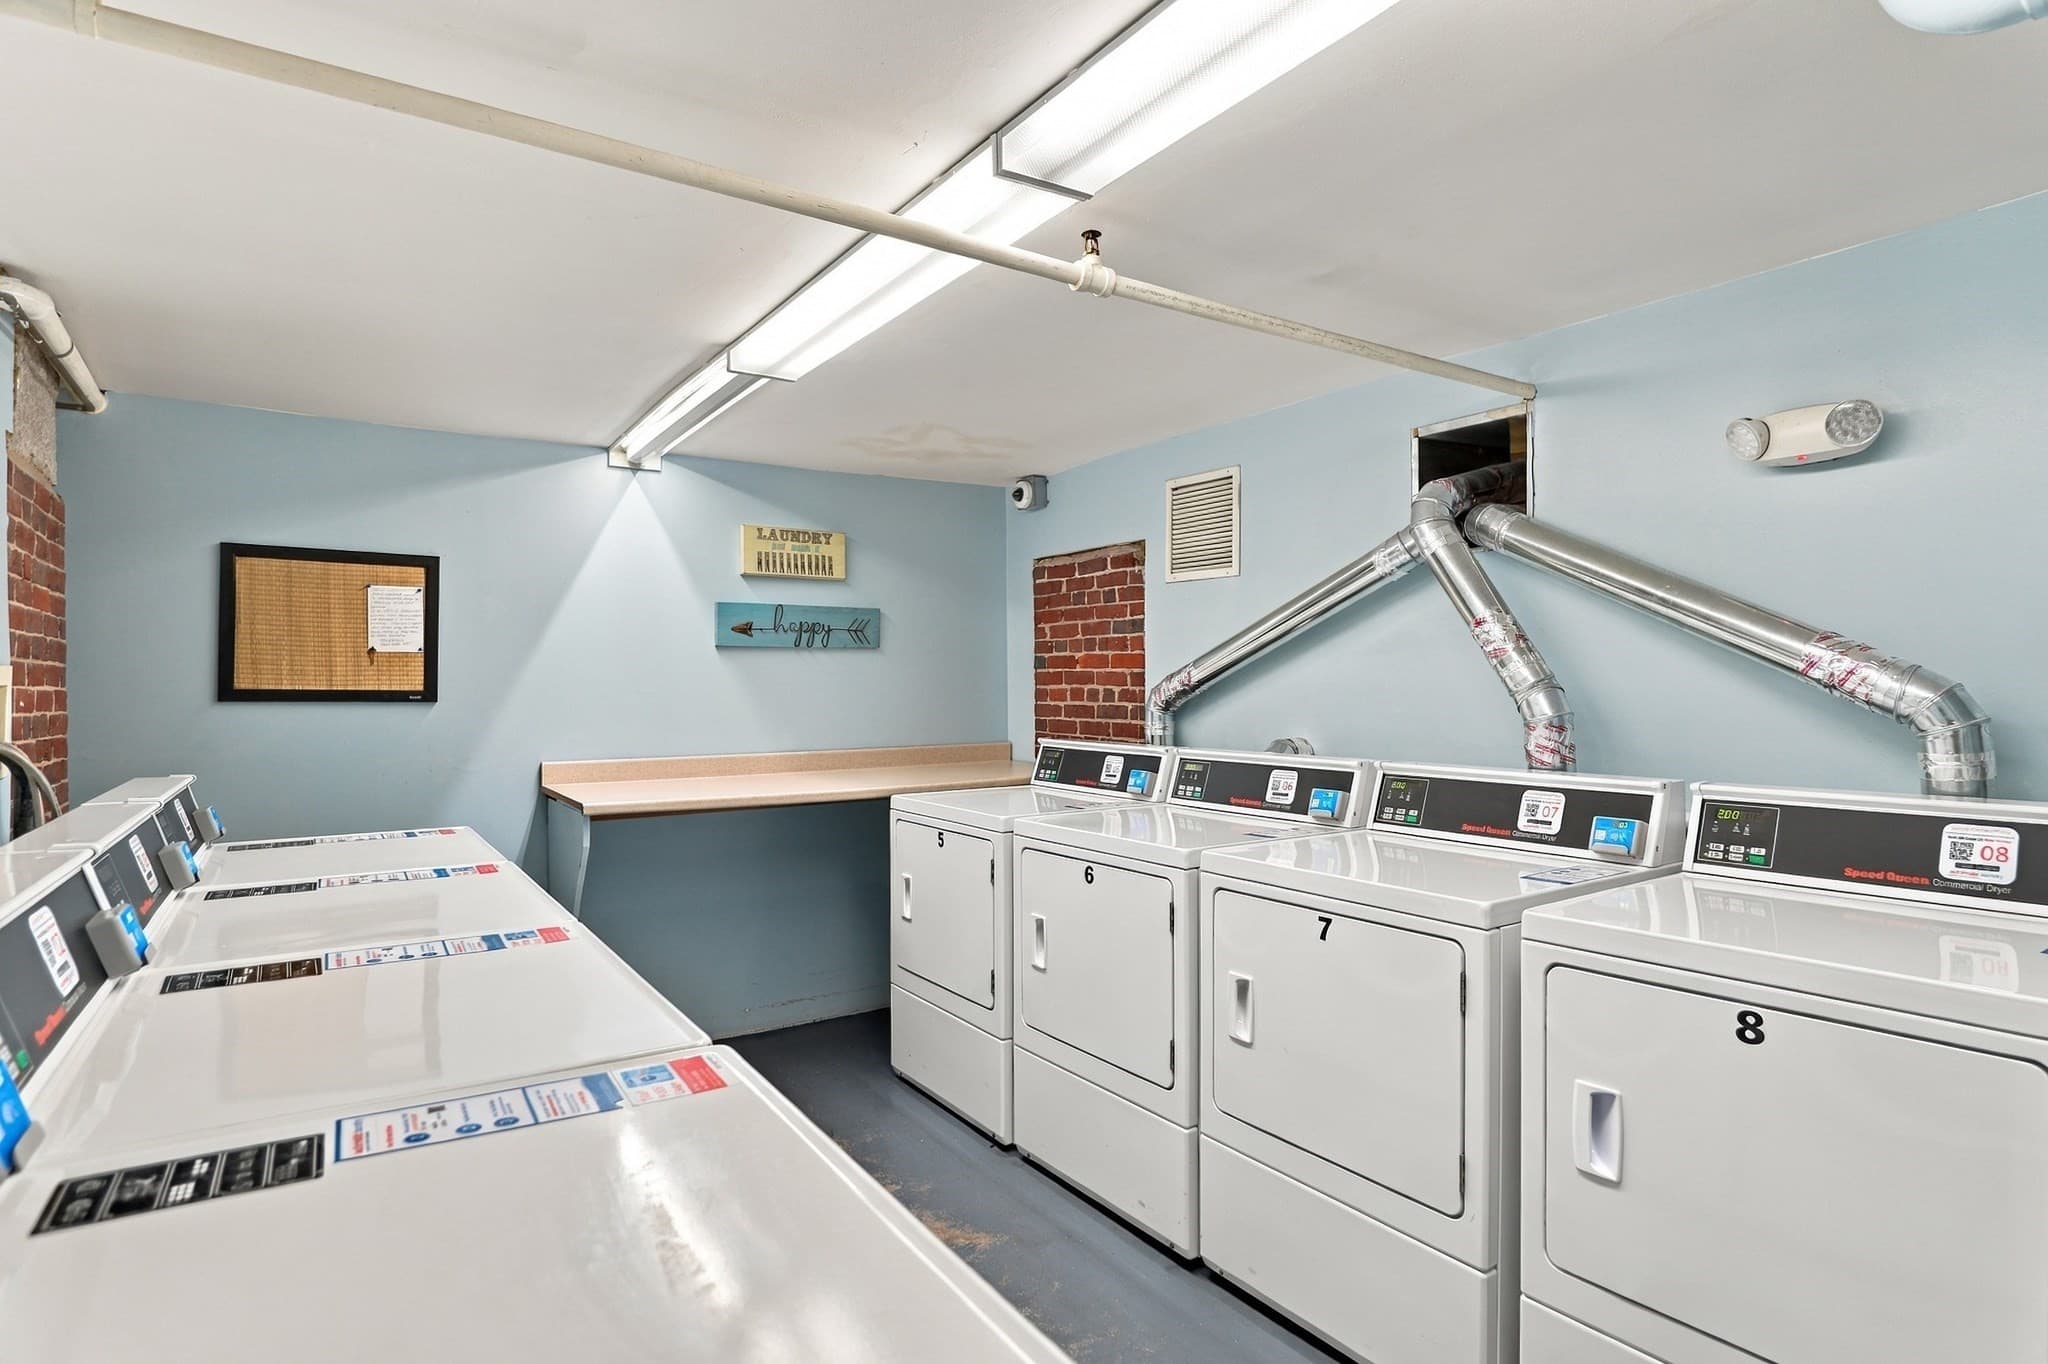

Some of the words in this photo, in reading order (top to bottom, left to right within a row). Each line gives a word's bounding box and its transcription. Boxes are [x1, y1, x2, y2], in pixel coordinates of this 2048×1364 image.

[757, 527, 833, 545] LAUNDRY
[773, 604, 832, 648] happy
[1542, 805, 1559, 818] 07
[1462, 822, 1486, 834] Speed
[938, 831, 945, 848] 5
[1980, 845, 2009, 863] 08
[1084, 865, 1094, 884] 6
[1844, 867, 1885, 882] Speed
[1886, 871, 1930, 885] Queen
[1932, 878, 1984, 892] Commercial
[1986, 884, 2012, 896] Dryer
[1317, 916, 1332, 941] 7
[1735, 1010, 1766, 1046] 8
